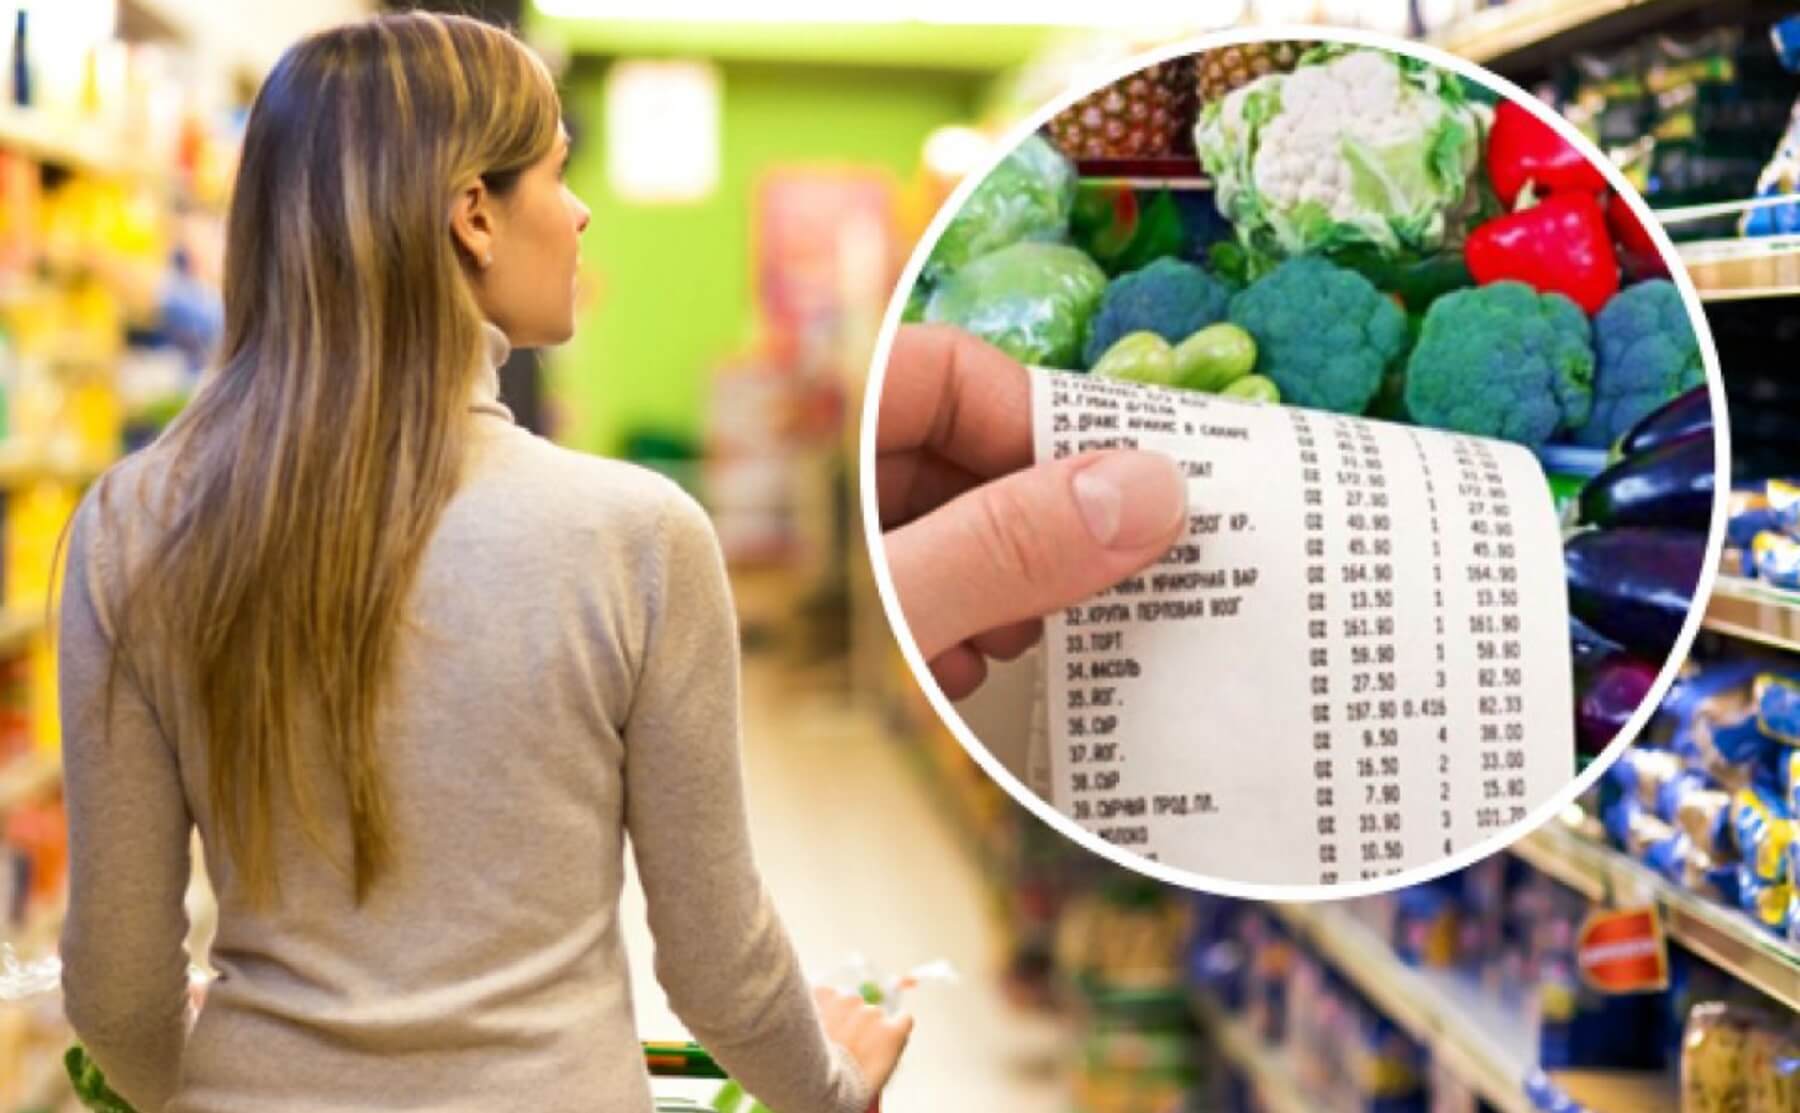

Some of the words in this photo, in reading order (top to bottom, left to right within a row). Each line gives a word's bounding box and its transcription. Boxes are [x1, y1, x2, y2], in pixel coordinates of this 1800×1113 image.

[1341, 564, 1392, 583] 164.90
[1467, 566, 1517, 582] 164.90
[1351, 589, 1393, 610] 13.50
[1477, 589, 1517, 607] 13.50
[1067, 631, 1122, 653] 33.ТОРТ
[1352, 672, 1396, 693] 27.50
[1478, 667, 1521, 687] 82.50
[1479, 696, 1522, 715] 82.33
[1363, 728, 1398, 748] 9.50
[1480, 723, 1523, 742] 38.00
[1357, 756, 1398, 777] 16.50
[1482, 750, 1524, 771] 33.00
[1366, 784, 1400, 804] 7.90
[1361, 840, 1403, 861] 10.50
